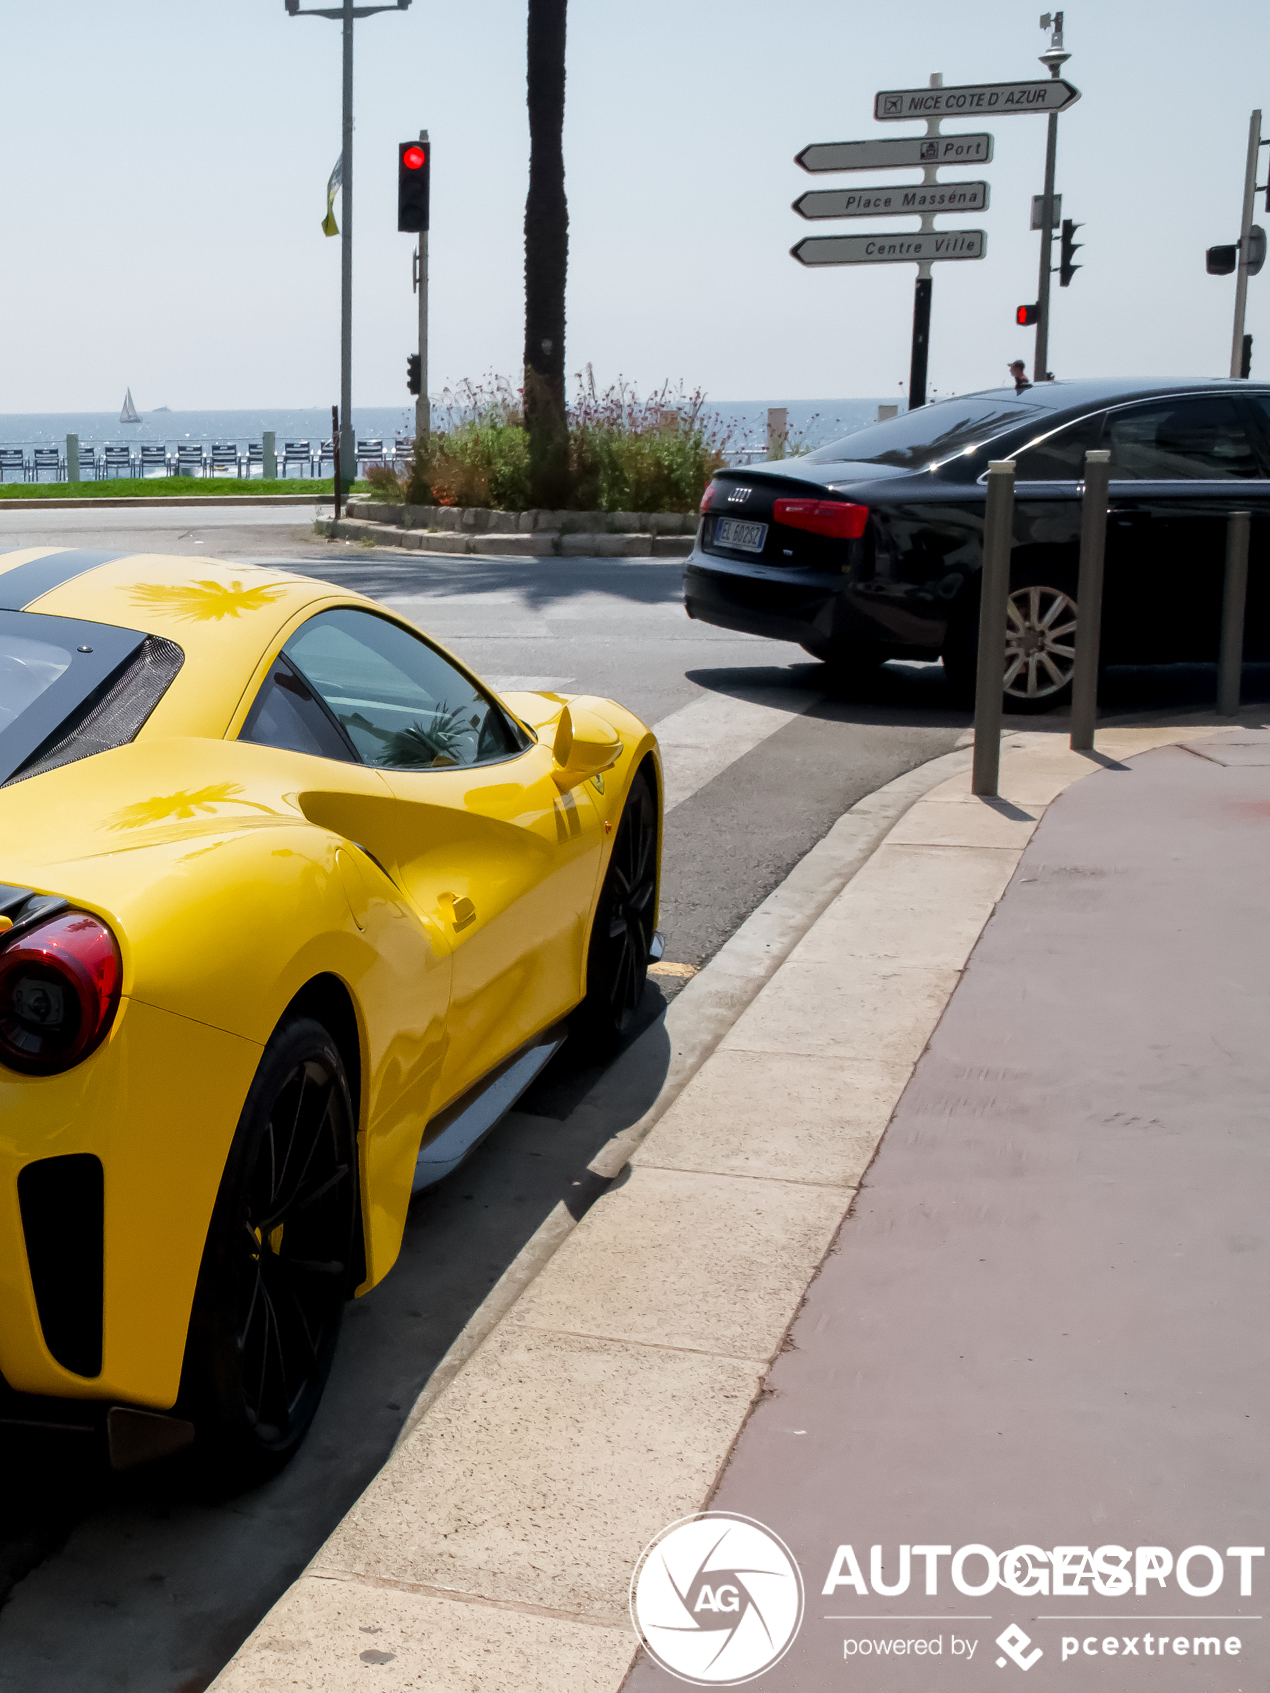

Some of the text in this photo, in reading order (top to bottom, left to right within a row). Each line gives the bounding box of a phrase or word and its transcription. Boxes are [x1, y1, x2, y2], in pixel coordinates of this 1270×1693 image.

[908, 96, 942, 111] NICE
[945, 93, 987, 108] COTE
[943, 142, 982, 156] Port
[845, 190, 978, 210] Place Masséna
[865, 238, 975, 256] Centre Ville
